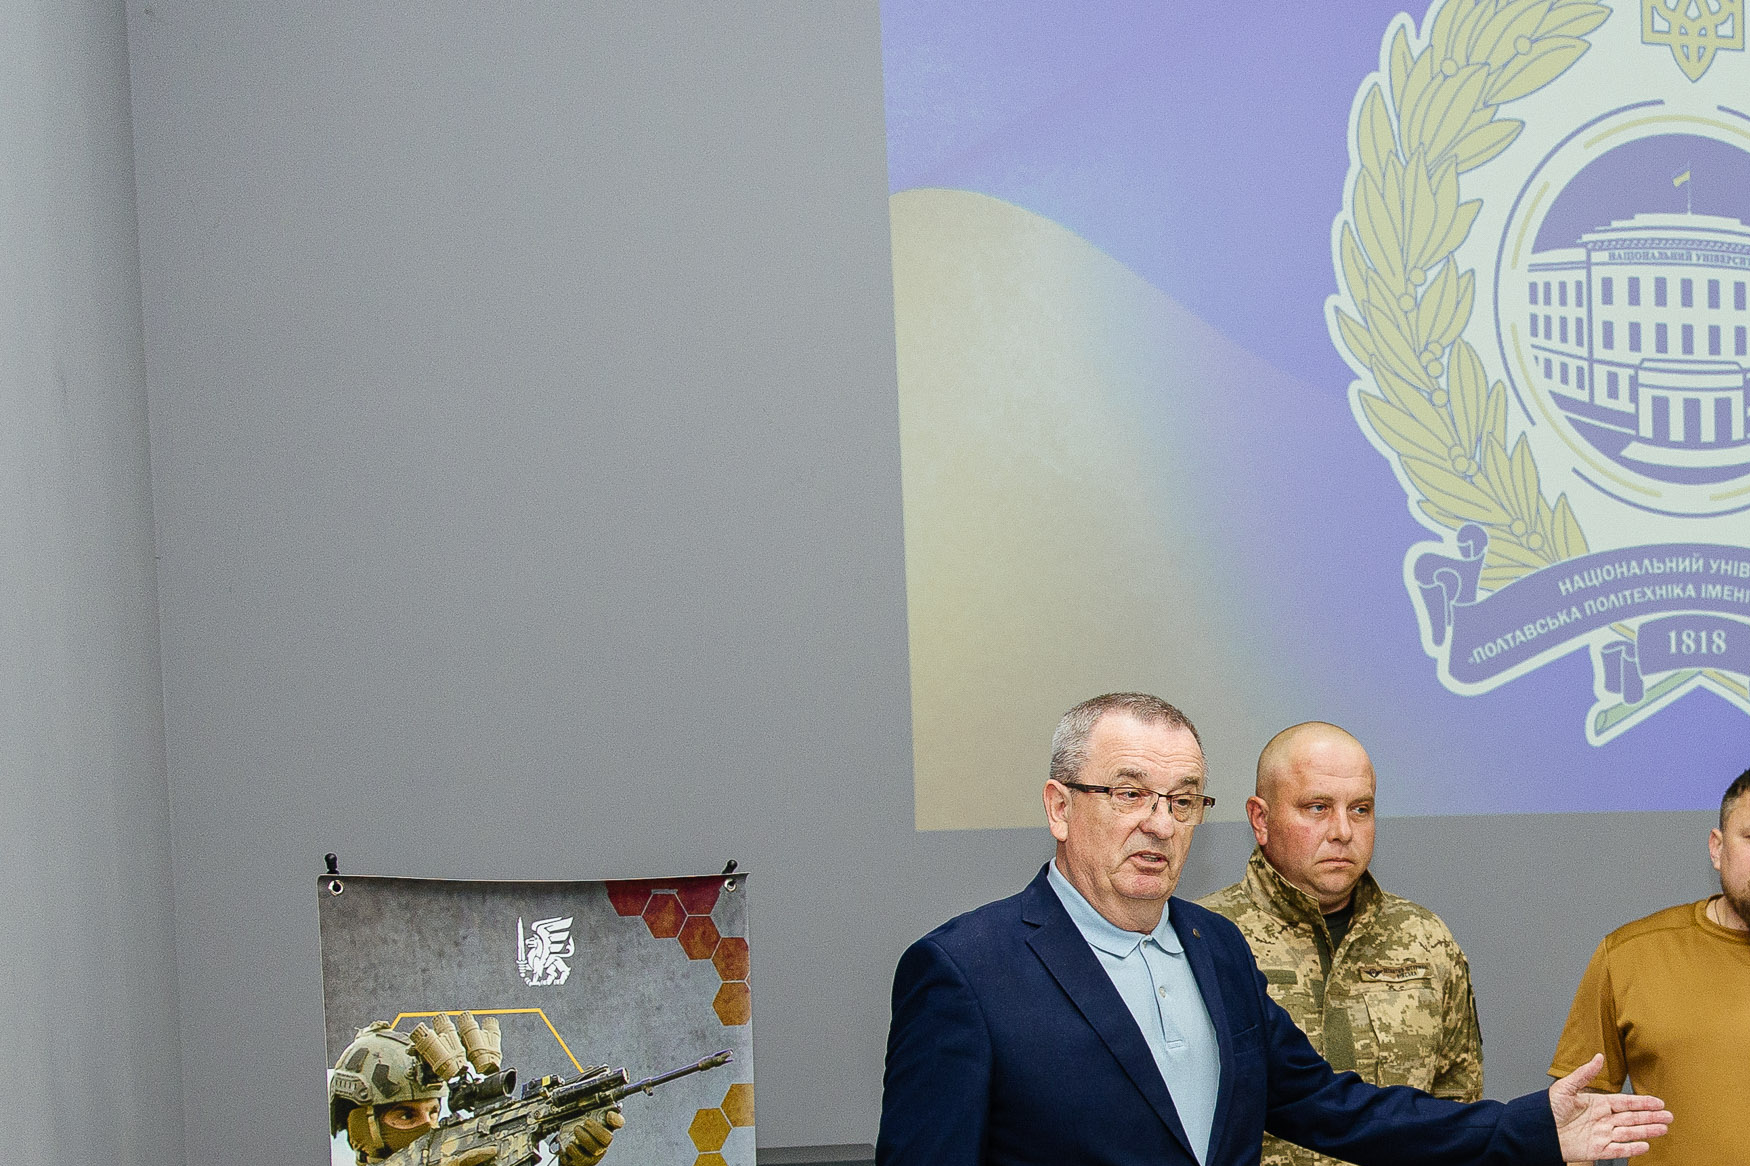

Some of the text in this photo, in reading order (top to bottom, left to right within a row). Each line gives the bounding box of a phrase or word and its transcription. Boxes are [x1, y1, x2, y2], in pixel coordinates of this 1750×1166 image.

[1608, 250, 1692, 262] НАЦІОНАЛЬНИЙ
[1558, 552, 1704, 596] НАЦІОНАЛЬНИЙ
[1584, 583, 1696, 616] ПОЛІТЕХНІКА
[1701, 583, 1750, 604] ІМЕНІ
[1668, 629, 1727, 655] 1818
